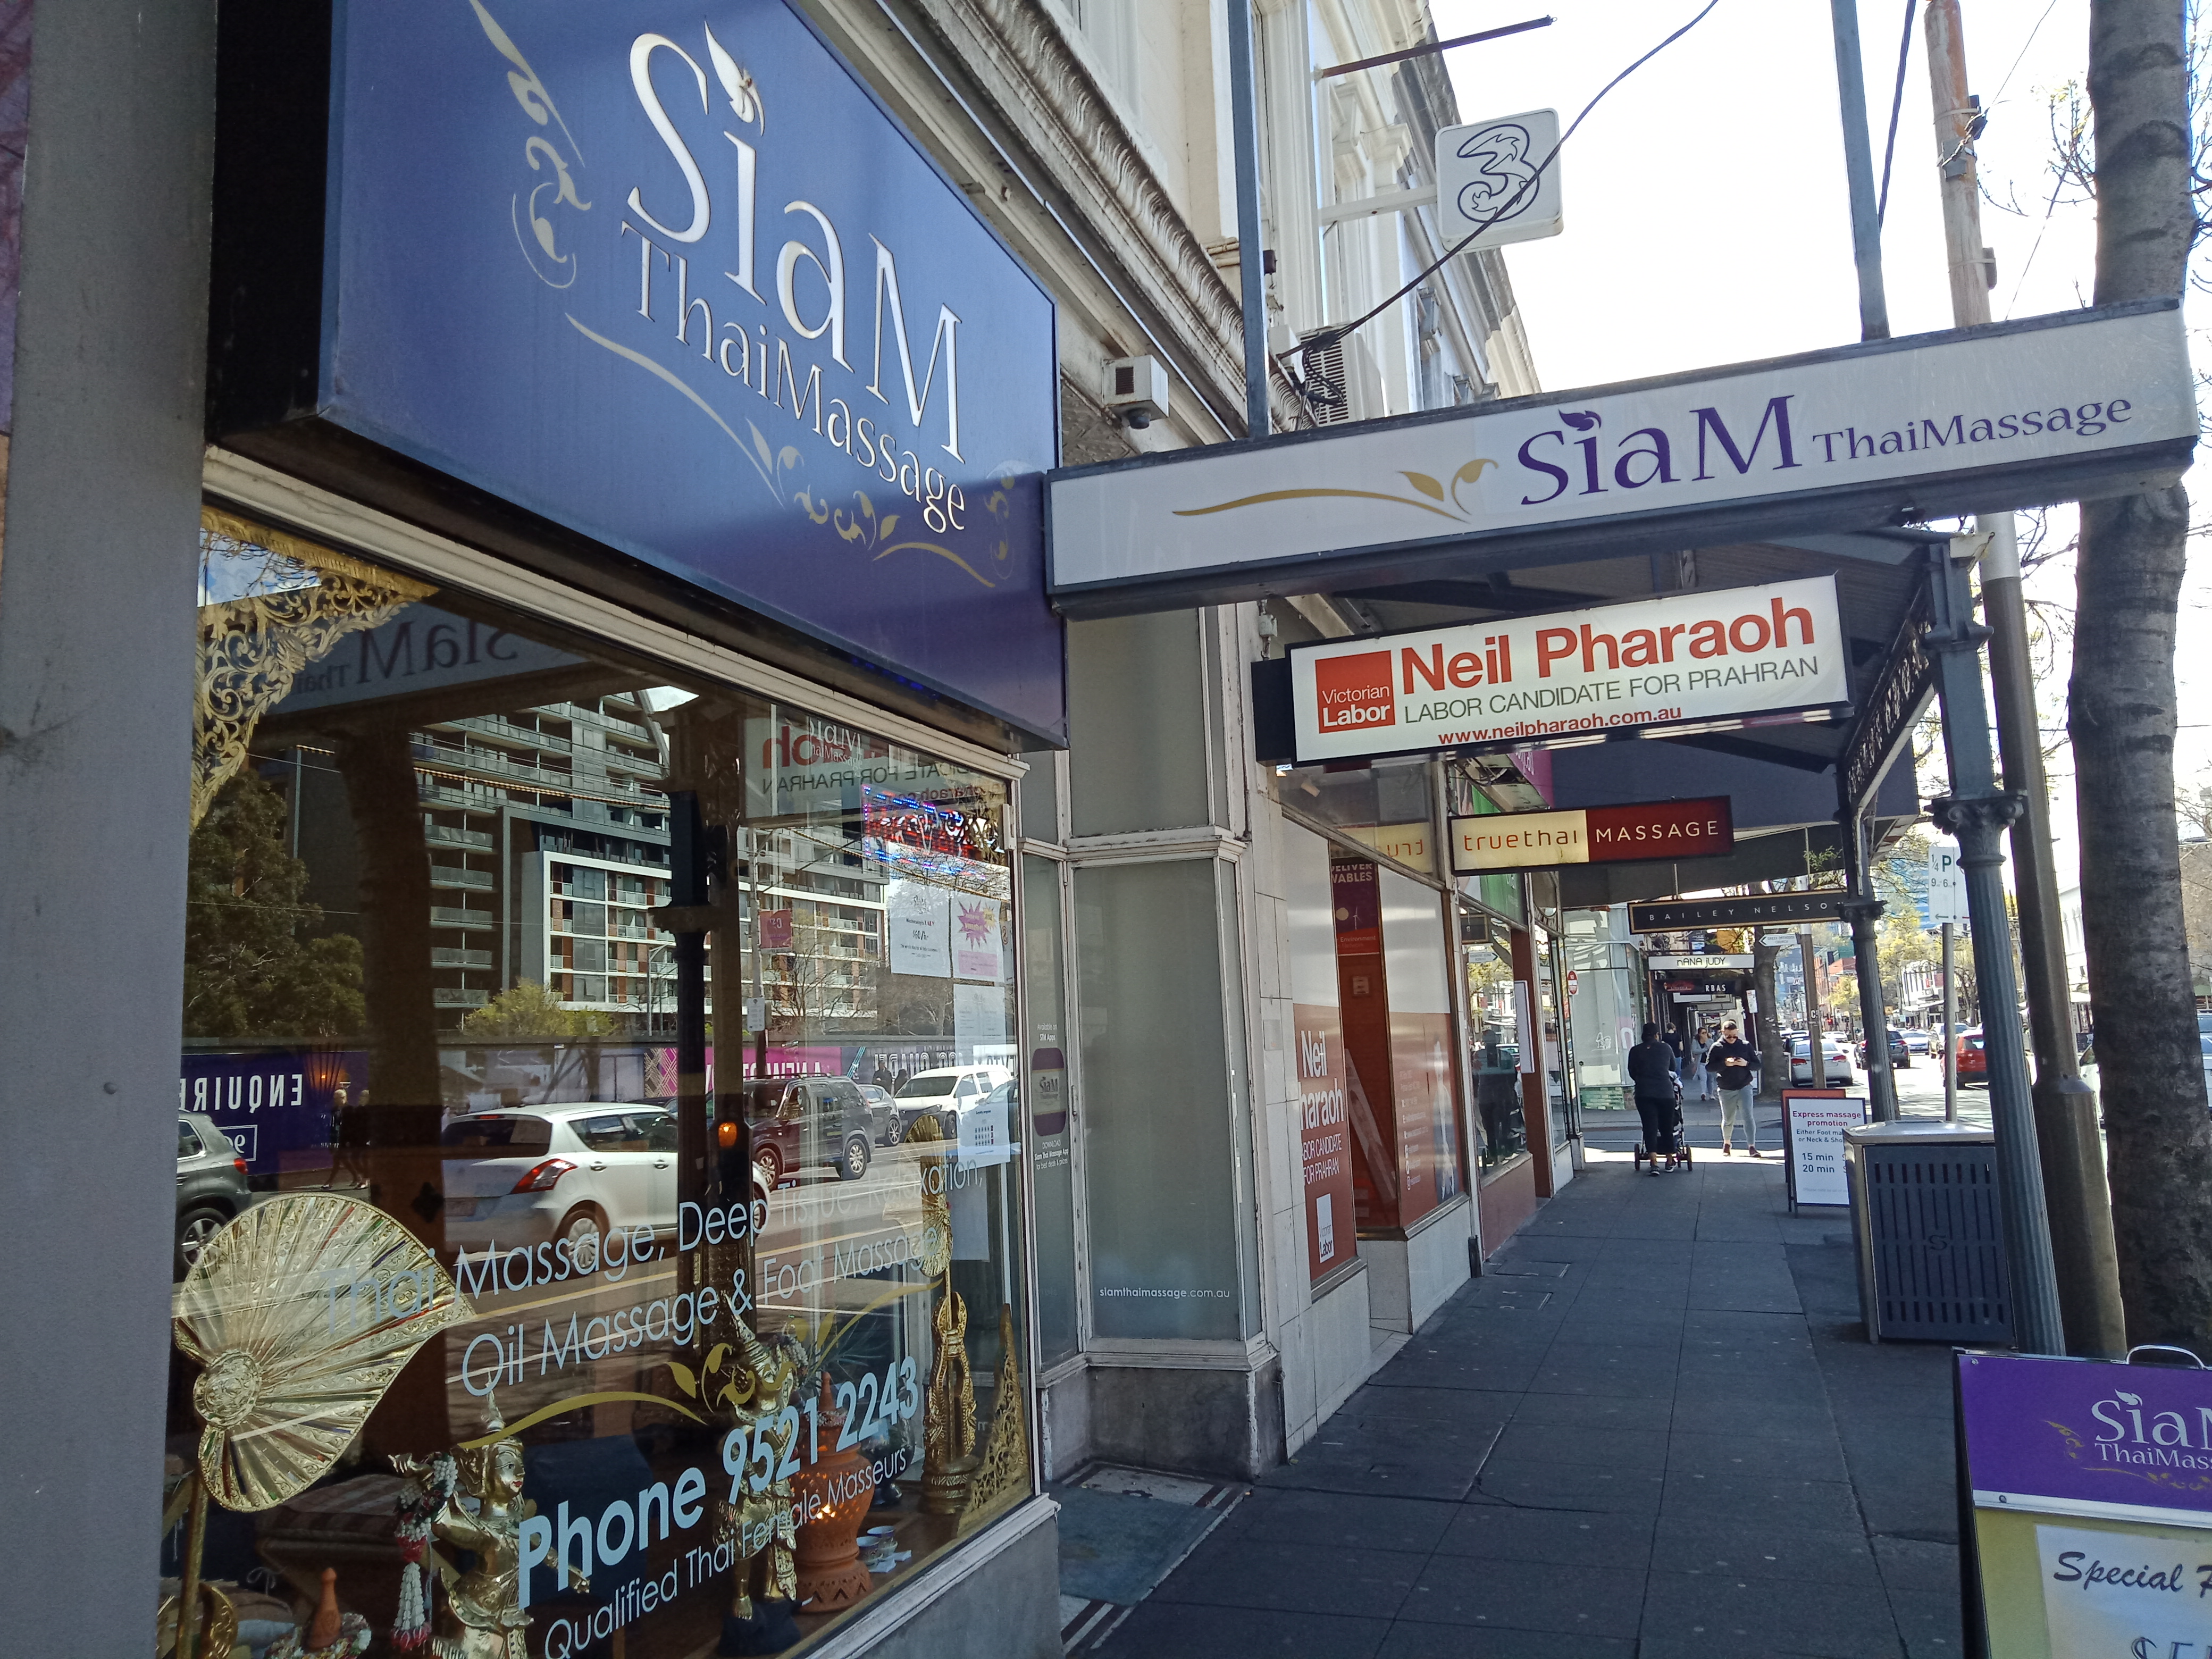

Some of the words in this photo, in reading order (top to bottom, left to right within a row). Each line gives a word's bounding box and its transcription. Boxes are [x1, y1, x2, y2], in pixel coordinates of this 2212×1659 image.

[622, 221, 965, 534] ThaiMassage
[1812, 397, 2133, 464] ThaiMassage
[1402, 634, 1512, 694] Neil
[1535, 597, 1816, 678] Pharaoh
[1322, 683, 1390, 705] Victorian
[1404, 698, 1483, 724] LABOR
[1489, 681, 1622, 714] CANDIDATE
[1629, 674, 1682, 698] FOR
[1688, 656, 1819, 688] PRAHRAN
[1323, 702, 1390, 728] Labor
[1437, 705, 1683, 745] www.neilpharaoh.com.au
[1464, 829, 1578, 851] truethai
[1595, 819, 1720, 844] MASSAGE
[1942, 854, 1951, 872] P
[1649, 908, 1734, 921] BAILEY
[1755, 901, 1844, 914] NELSO
[1301, 1029, 1328, 1078] Neil
[1298, 1077, 1345, 1131] haraoh
[1802, 1152, 1813, 1161] 15
[1815, 1153, 1834, 1161] min
[1803, 1164, 1814, 1172] 20
[1816, 1164, 1835, 1173] min
[452, 1221, 667, 1303] Massage,
[678, 1197, 770, 1252] Deep
[1320, 1239, 1333, 1258] Labor
[462, 1323, 524, 1397] Oil
[540, 1285, 719, 1376] Massage
[731, 1268, 754, 1316] &
[763, 1254, 825, 1306] Foot
[833, 1226, 938, 1285] Massage
[1099, 1287, 1230, 1299] siamthaimassage.com.au
[2094, 1442, 2212, 1470] ThaiMas
[518, 1467, 707, 1610] Phone
[722, 1396, 818, 1505] 9521
[834, 1355, 918, 1453] 2243
[544, 1569, 678, 1659] Qualified
[685, 1529, 734, 1589] Thai
[742, 1489, 822, 1559] Female
[827, 1446, 907, 1507] Masseurs
[2053, 1551, 2183, 1593] Special
